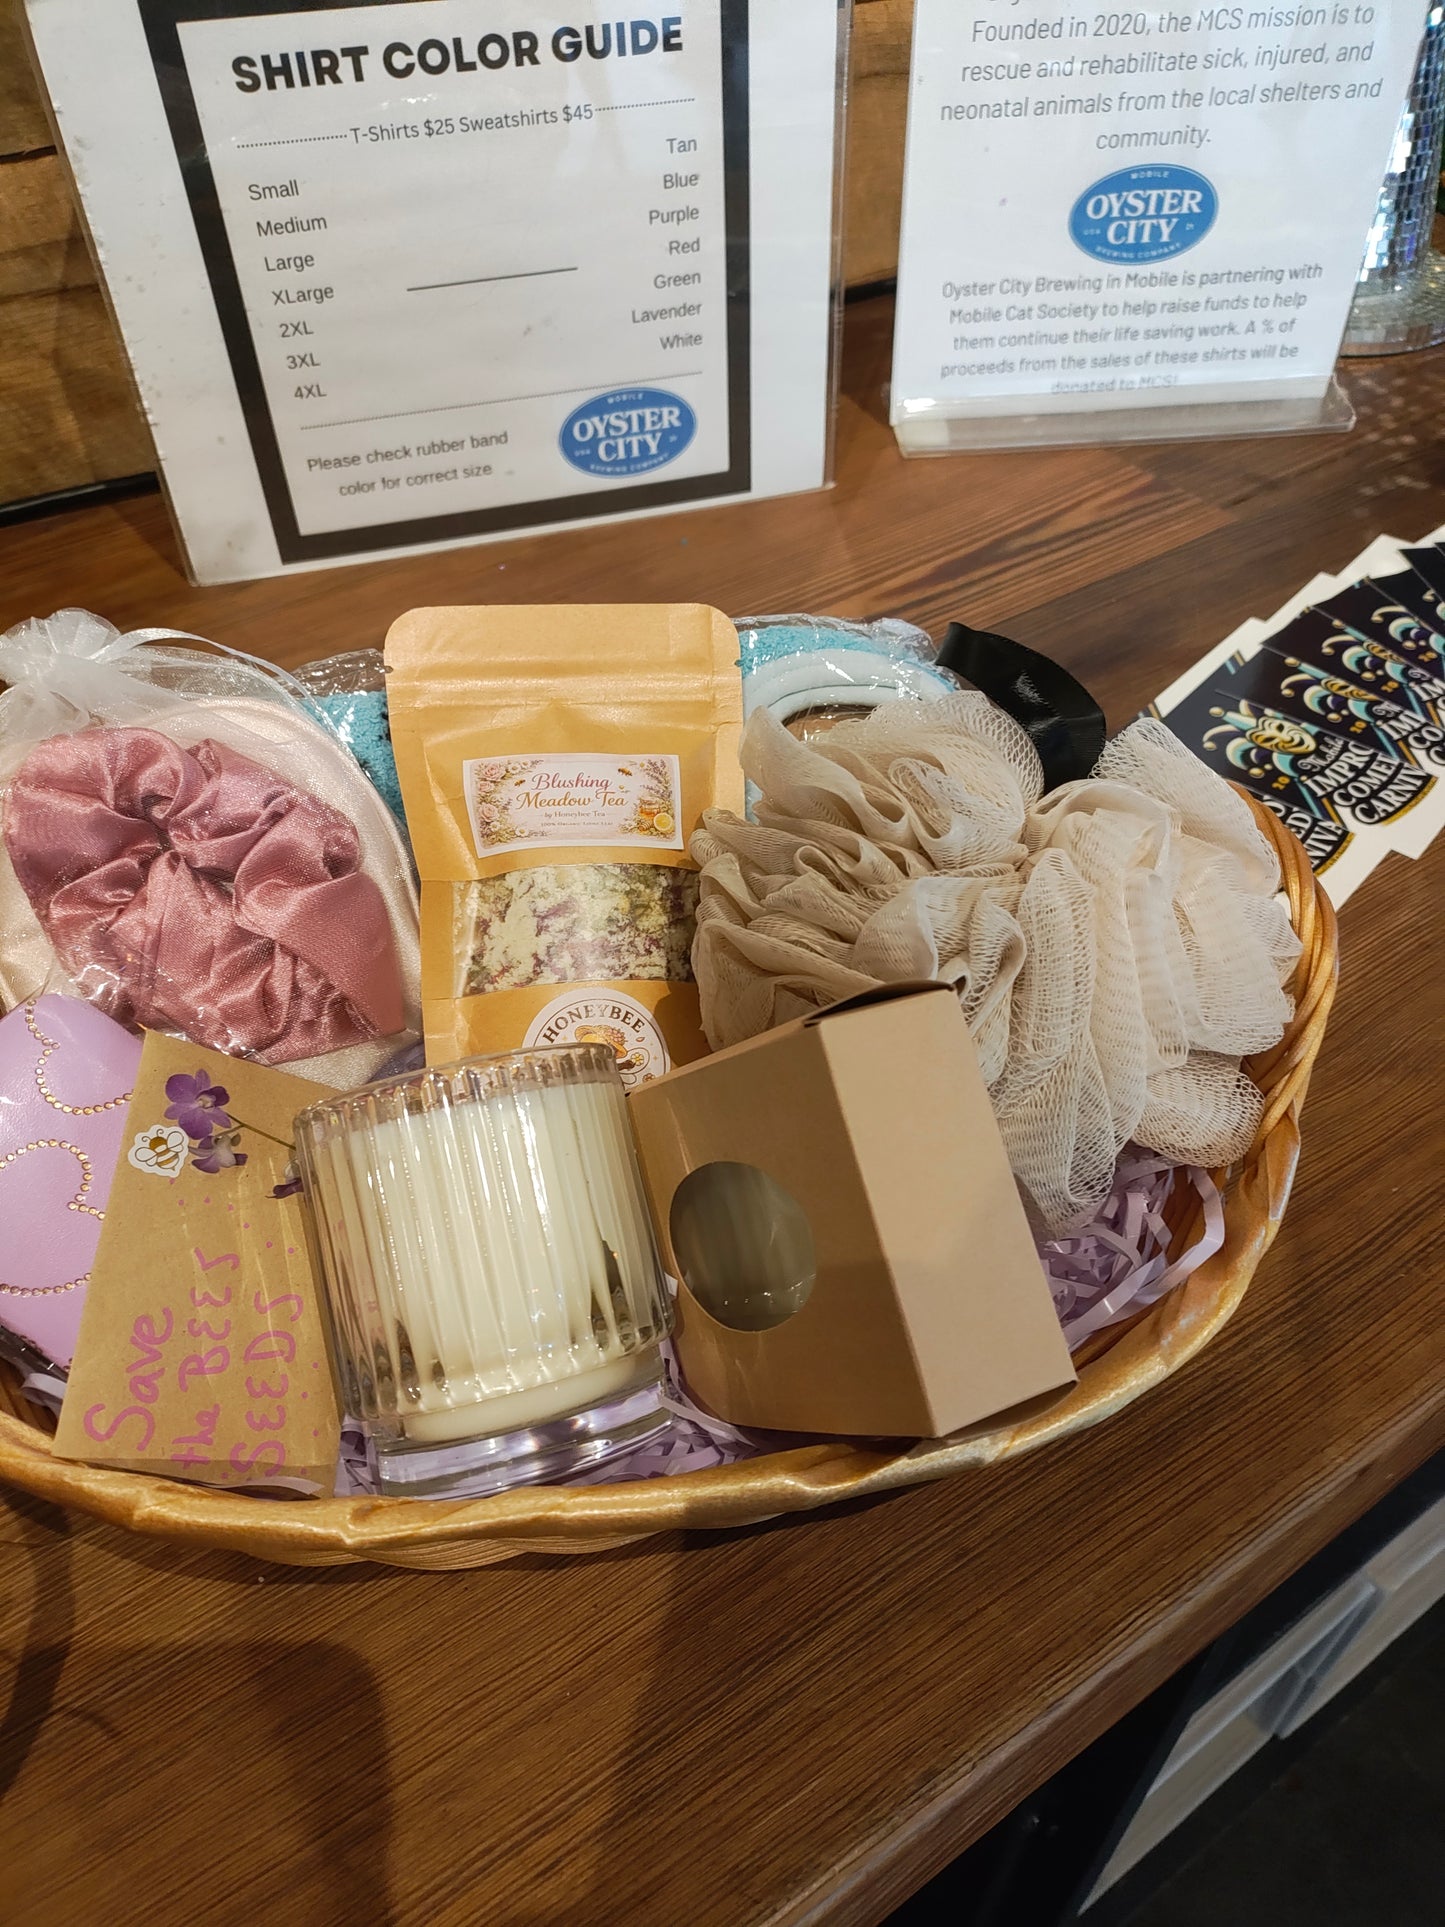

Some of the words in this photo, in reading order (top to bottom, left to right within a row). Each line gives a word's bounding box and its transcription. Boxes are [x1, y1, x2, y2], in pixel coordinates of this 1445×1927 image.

[972, 17, 1063, 43] Founded
[1069, 16, 1087, 37] in
[1093, 13, 1151, 37] 2020,
[1157, 11, 1191, 34] the
[1198, 8, 1244, 31] MCS
[1247, 4, 1326, 28] mission
[1331, 3, 1350, 25] is
[1354, 4, 1374, 25] to
[232, 45, 369, 93] SHIRT
[382, 31, 541, 79] COLOR
[551, 16, 684, 61] GUIDE
[961, 61, 1032, 83] rescue
[1036, 56, 1073, 78] and
[1079, 50, 1198, 76] rehabilitate
[1203, 48, 1249, 71] sick,
[1254, 44, 1330, 70] injured,
[1336, 41, 1375, 63] and
[941, 97, 1029, 121] neonatal
[1033, 93, 1113, 117] animals
[1118, 90, 1166, 113] from
[1171, 88, 1204, 110] the
[1208, 84, 1255, 107] local
[1259, 79, 1340, 104] shelters
[1345, 78, 1383, 99] and
[350, 121, 420, 145] T-Shirts
[424, 117, 456, 138] $25
[459, 107, 558, 134] Sweatshirts
[562, 103, 594, 124] $45
[666, 136, 698, 155] Tan
[1096, 126, 1212, 152] community.
[662, 171, 699, 191] Blue
[1130, 170, 1170, 179] MOBILE
[247, 179, 300, 202] Small
[648, 205, 700, 228] Purple
[1086, 189, 1203, 220] OYSTER
[256, 213, 328, 238] Medium
[1107, 218, 1179, 245] CITY
[668, 238, 701, 257] Red
[264, 251, 315, 274] Large
[653, 271, 702, 291] Green
[942, 281, 996, 300] Oyster
[999, 277, 1031, 298] City
[1034, 273, 1102, 295] Brewing
[1105, 274, 1121, 291] in
[1124, 271, 1177, 290] Mobile
[1181, 270, 1196, 286] is
[1199, 267, 1285, 288] partnering
[1289, 263, 1323, 281] with
[272, 285, 335, 307] XLarge
[949, 307, 1002, 325] Mobile
[1005, 304, 1033, 322] Cat
[1037, 301, 1099, 323] Society
[1101, 301, 1119, 317] to
[1122, 298, 1157, 320] help
[1160, 297, 1200, 314] raise
[1204, 293, 1250, 311] funds
[1253, 293, 1270, 309] to
[1273, 290, 1308, 312] help
[631, 301, 702, 325] Lavender
[279, 321, 314, 339] 2XL
[659, 331, 703, 351] White
[953, 333, 995, 351] them
[998, 328, 1069, 348] continue
[1073, 326, 1110, 345] their
[1114, 323, 1139, 342] life
[1142, 323, 1195, 344] saving
[1198, 319, 1240, 337] work.
[1244, 319, 1257, 335] A
[1261, 318, 1275, 335] %
[1279, 316, 1297, 334] of
[286, 352, 321, 370] 3XL
[940, 357, 1015, 379] proceeds
[1018, 355, 1057, 373] from
[1061, 353, 1086, 370] the
[1089, 350, 1130, 368] sales
[1133, 349, 1151, 366] of
[1154, 347, 1199, 364] these
[1202, 345, 1247, 363] shirts
[1250, 343, 1275, 360] will
[1279, 342, 1299, 359] be
[294, 383, 327, 400] 4XL
[572, 406, 682, 442] OYSTER
[307, 451, 362, 473] Please
[365, 443, 412, 467] check
[416, 436, 466, 459] rubber
[469, 431, 508, 449] band
[597, 432, 662, 463] CITY
[338, 478, 376, 498] color
[380, 473, 402, 492] for
[406, 467, 459, 488] correct
[462, 462, 492, 480] size
[531, 771, 613, 791] Blushing
[515, 791, 593, 810] Meadow
[595, 790, 629, 808] Tea
[177, 1246, 240, 1392] BEES
[83, 1306, 174, 1451] Save
[229, 1290, 303, 1478] SEEDS
[171, 1403, 220, 1469] the
